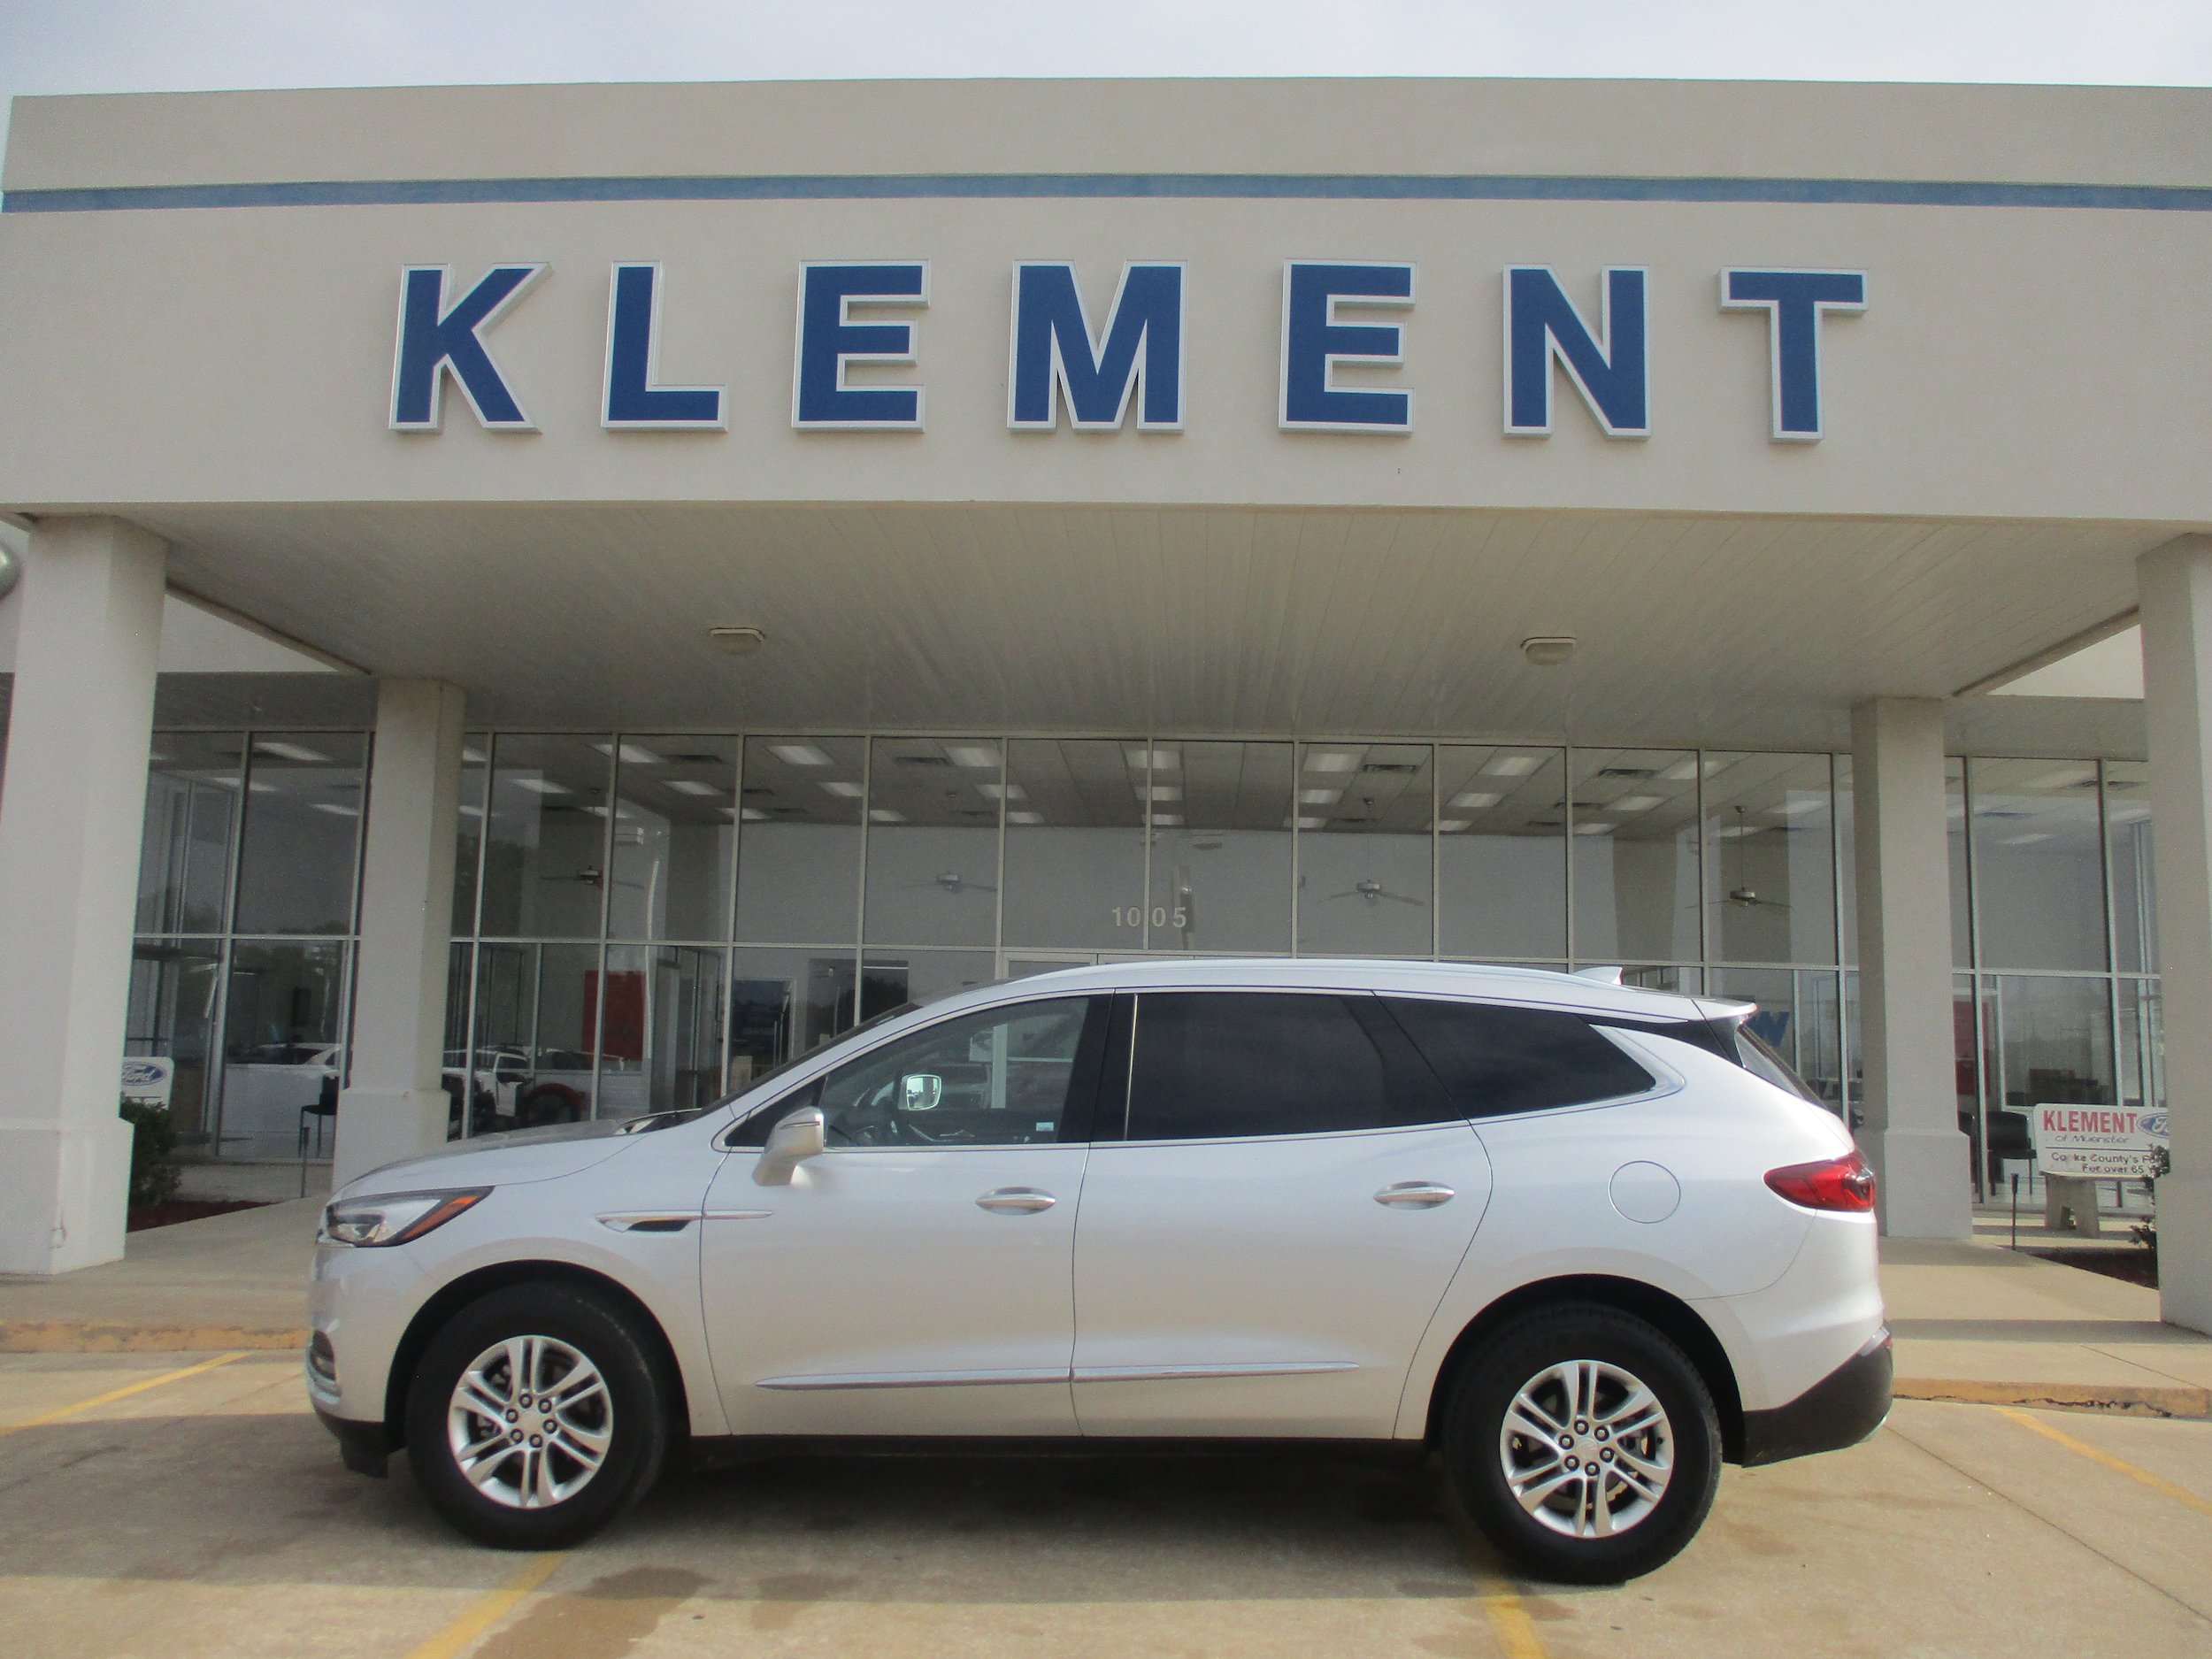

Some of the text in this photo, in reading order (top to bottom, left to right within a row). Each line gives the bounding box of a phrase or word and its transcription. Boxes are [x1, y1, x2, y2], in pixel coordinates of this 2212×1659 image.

[388, 259, 1866, 444] KLEMENT
[1111, 906, 1187, 928] 1005
[2043, 1110, 2138, 1133] KLEMENT
